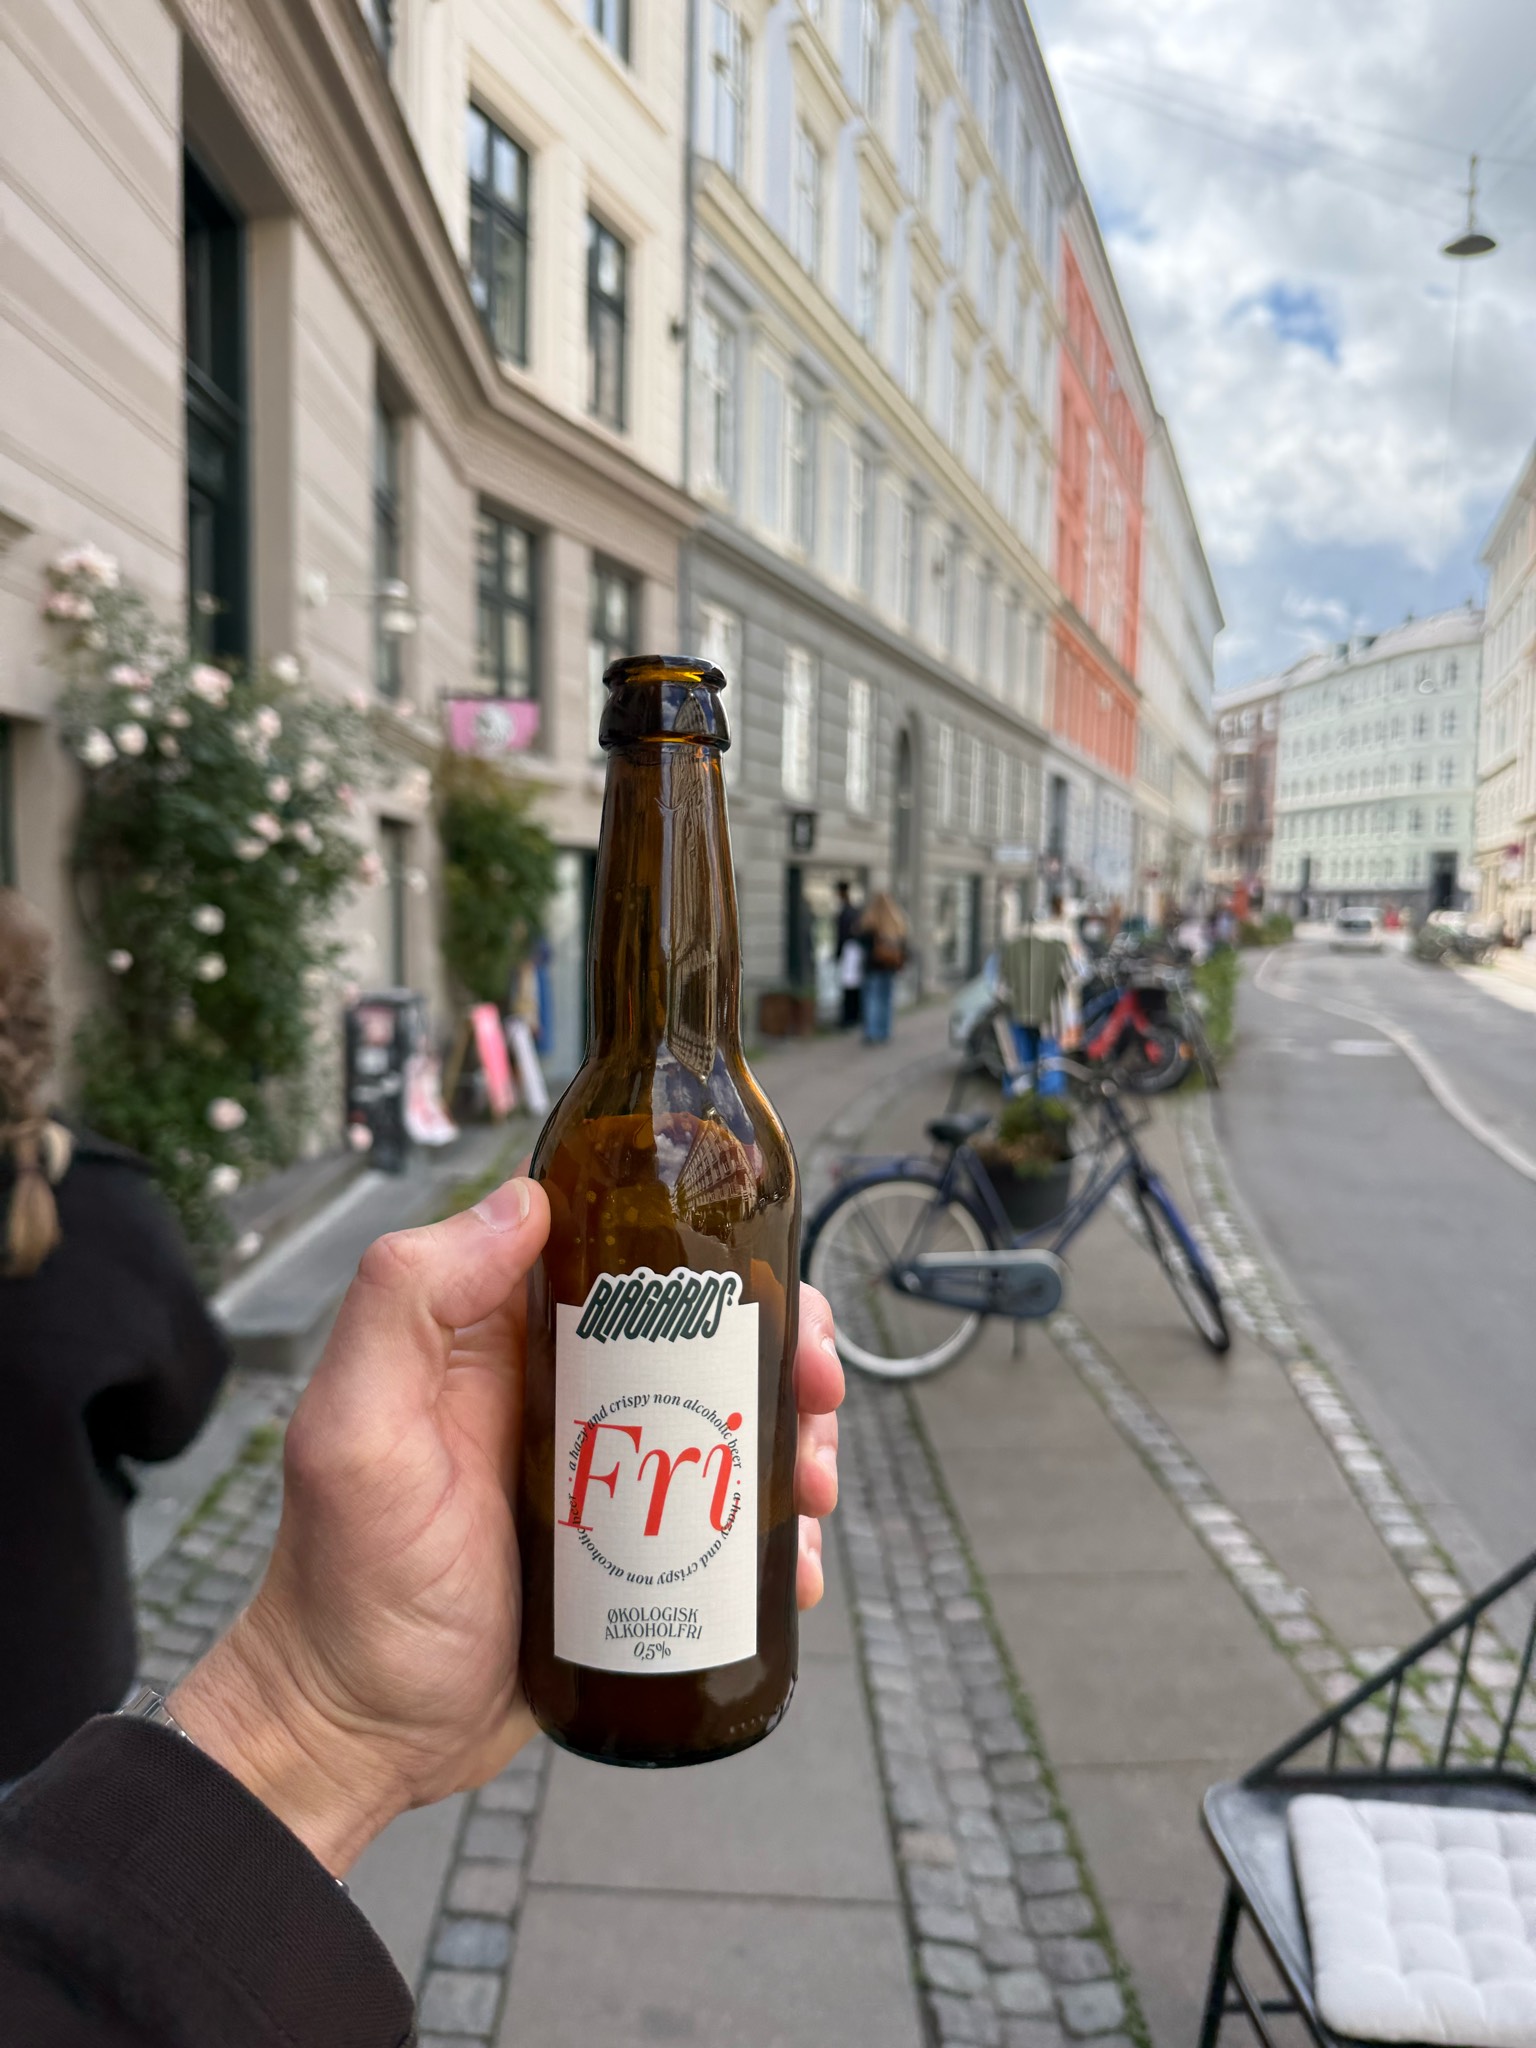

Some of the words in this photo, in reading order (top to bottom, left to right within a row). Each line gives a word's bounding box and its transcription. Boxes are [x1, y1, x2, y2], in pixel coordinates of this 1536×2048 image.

[609, 1393, 651, 1413] crispy
[653, 1393, 681, 1406] non
[587, 1404, 608, 1431] and
[682, 1399, 733, 1440] alcoholic
[569, 1427, 589, 1460] hazy
[727, 1438, 742, 1469] beer
[558, 1412, 743, 1536] Fri
[569, 1460, 577, 1471] a
[577, 1527, 625, 1578] alcoholic
[699, 1539, 722, 1568] and
[626, 1572, 654, 1585] non
[657, 1562, 698, 1585] crispy
[607, 1606, 699, 1624] ØKOLOGISK
[604, 1622, 703, 1640] ALKOHOLFRI
[633, 1641, 672, 1661] 0,5%
